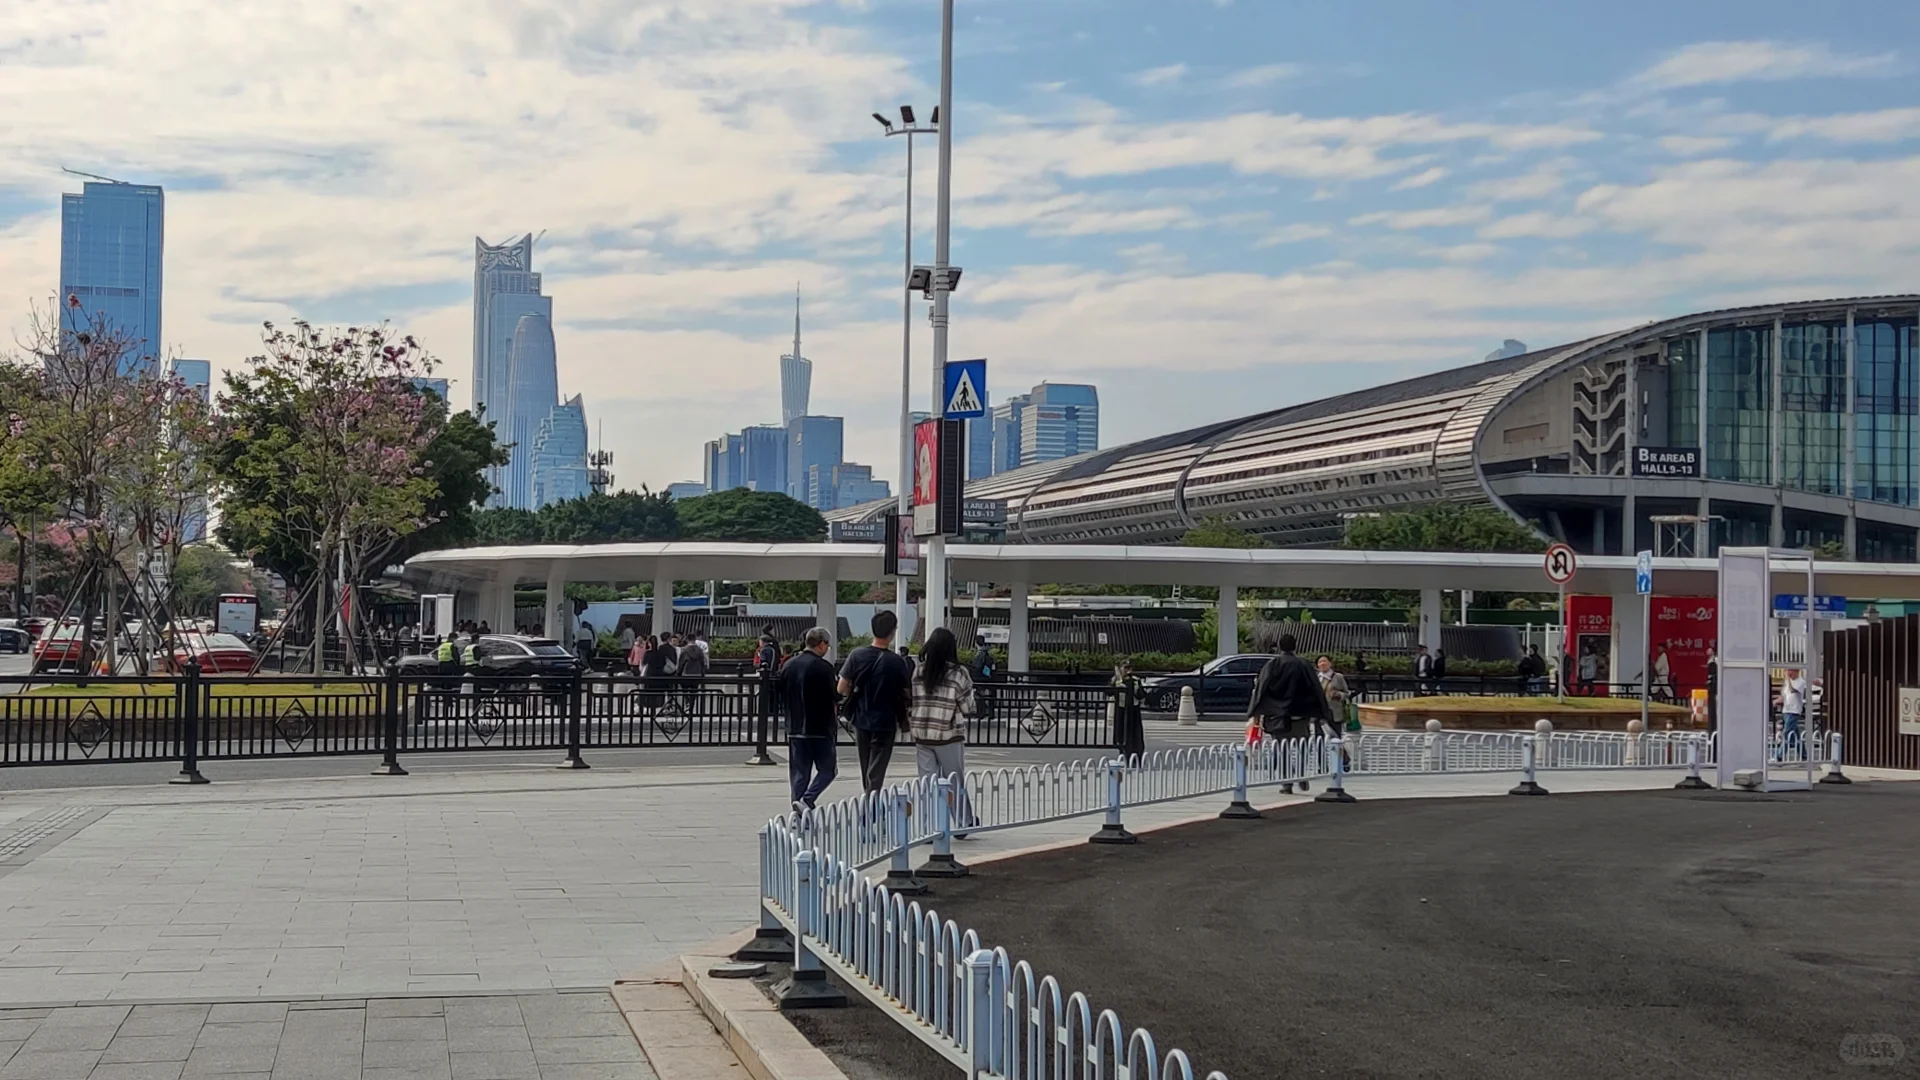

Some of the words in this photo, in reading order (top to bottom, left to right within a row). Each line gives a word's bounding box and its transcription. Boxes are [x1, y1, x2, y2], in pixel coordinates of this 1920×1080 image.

[1659, 453, 1686, 463] AREA
[1687, 453, 1695, 463] B
[1641, 464, 1669, 474] HALL
[1669, 465, 1693, 474] 9-13
